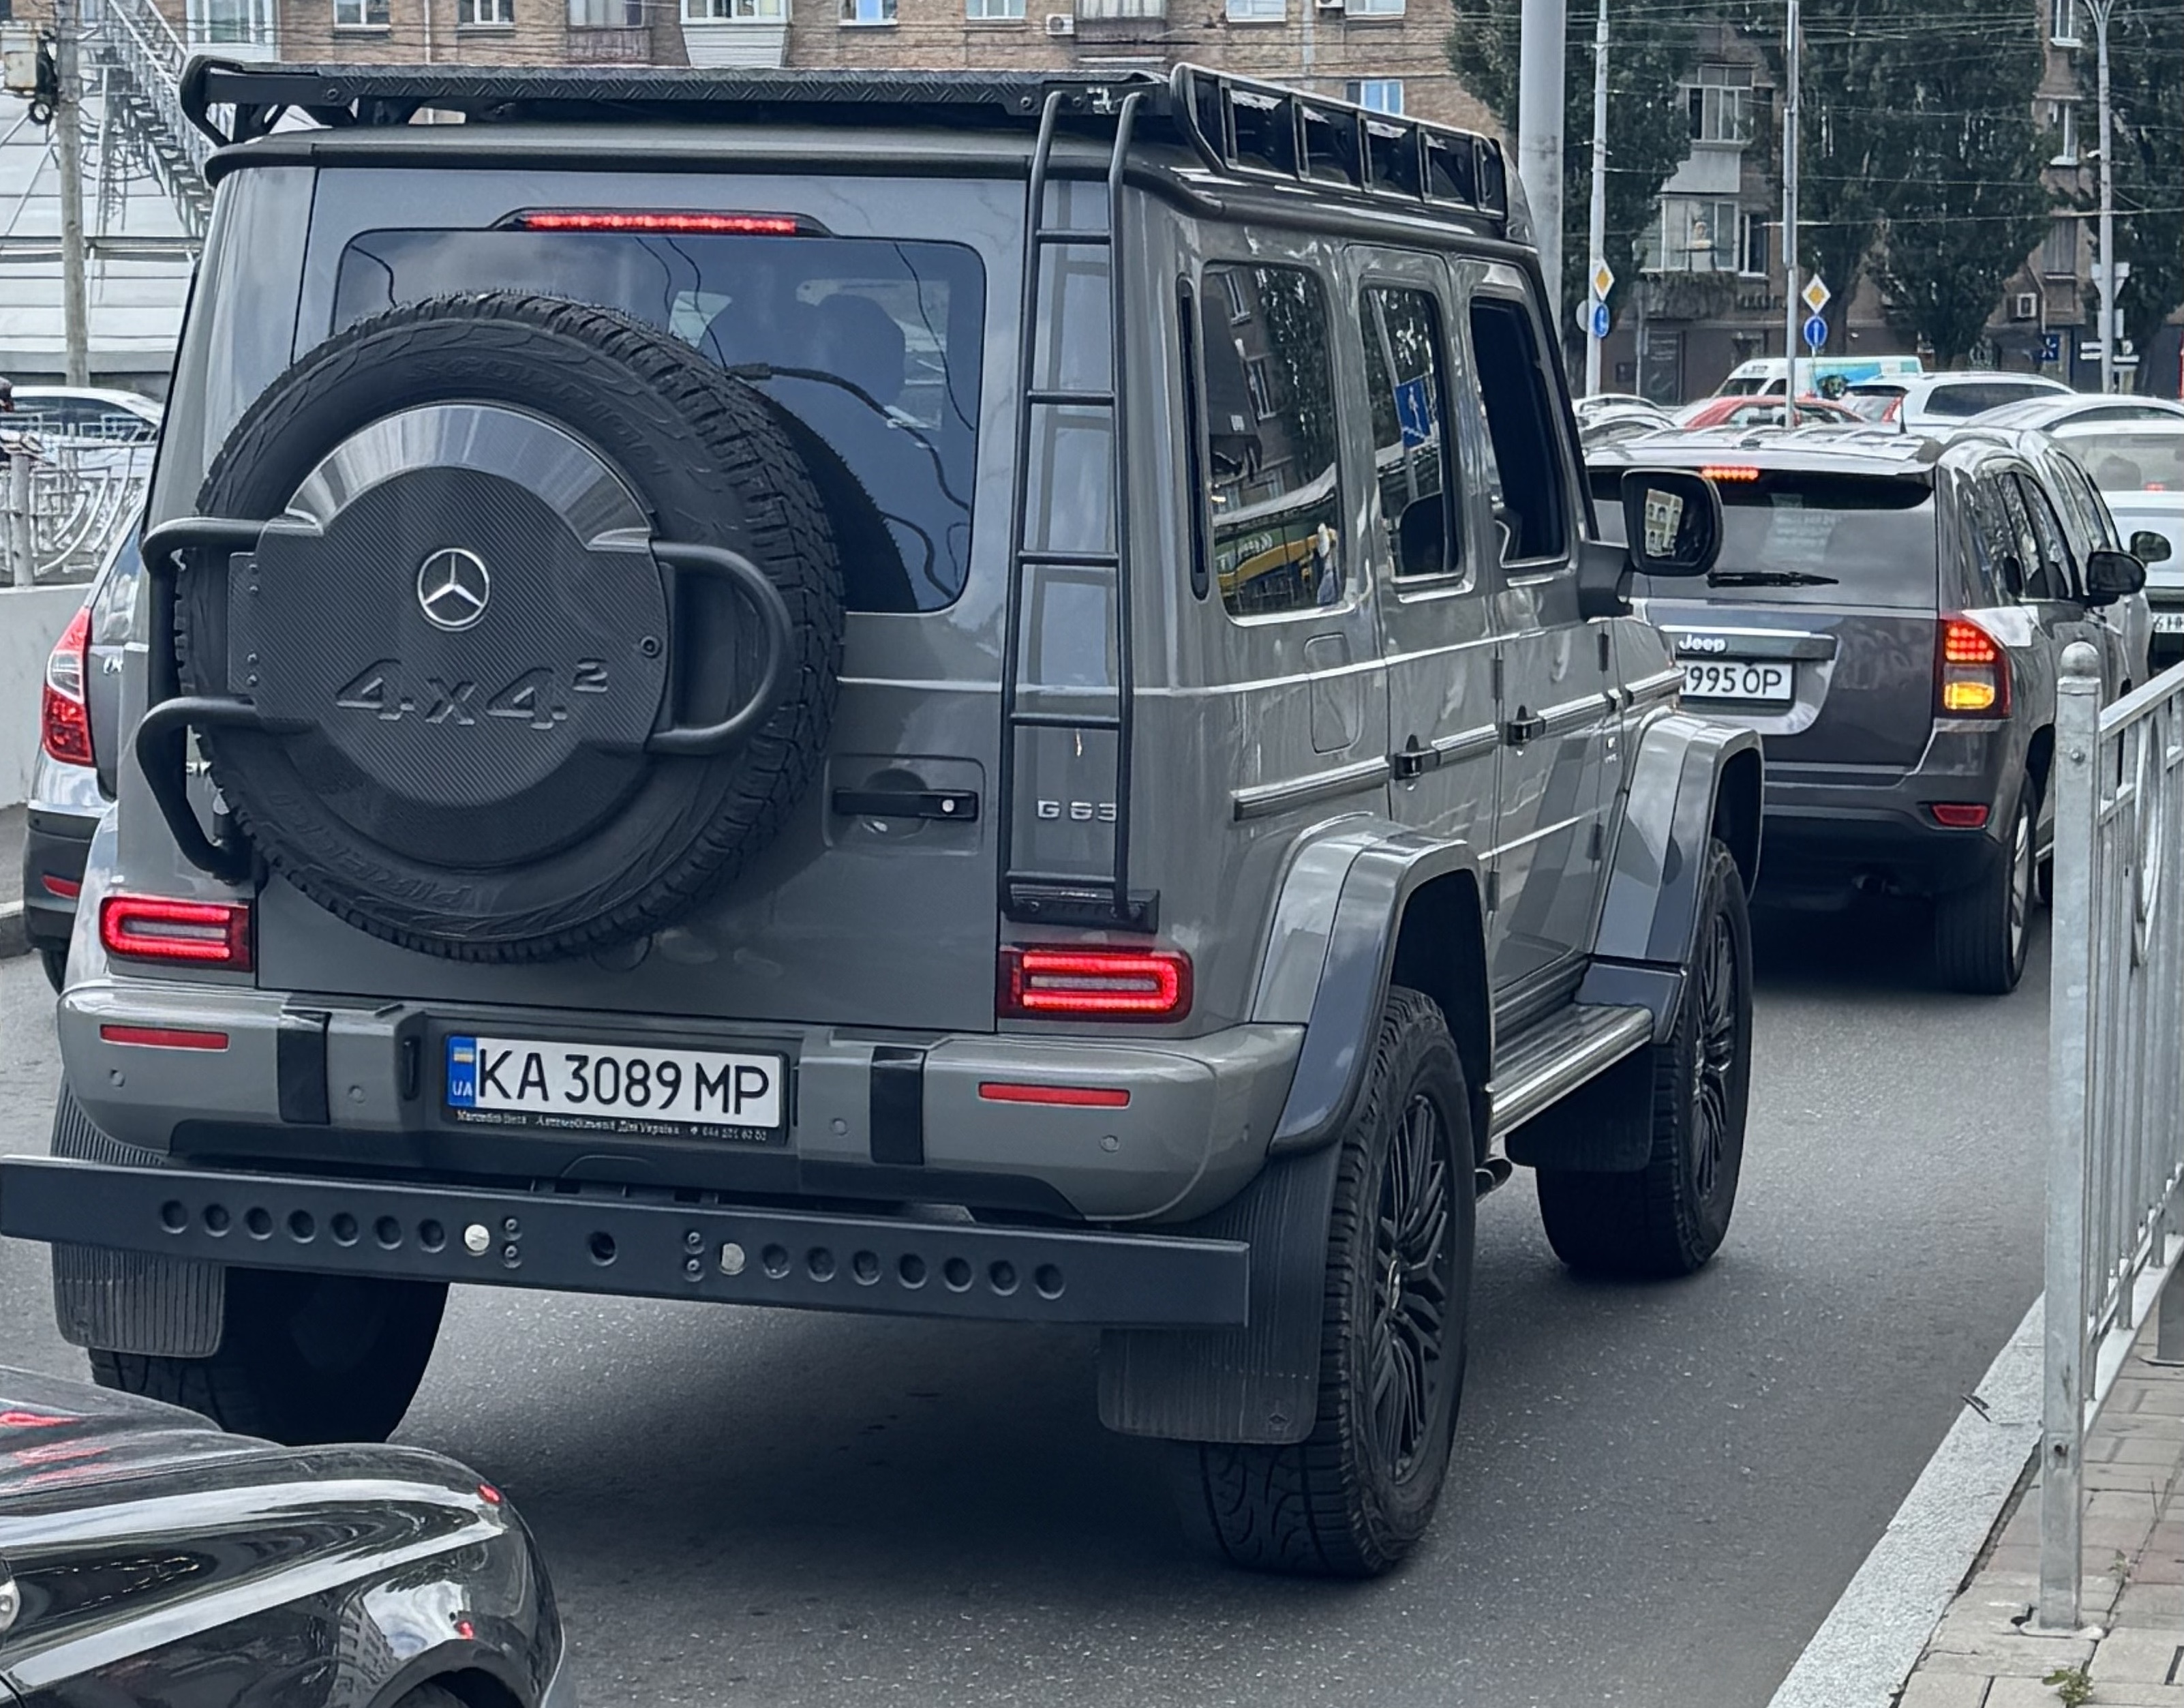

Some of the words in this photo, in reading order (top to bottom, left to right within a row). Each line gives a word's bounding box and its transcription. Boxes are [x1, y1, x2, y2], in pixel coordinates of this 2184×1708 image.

[1678, 634, 1726, 652] Jeep
[1742, 668, 1782, 695] OP
[452, 1079, 473, 1096] UA
[479, 1048, 549, 1101] KA
[564, 1053, 682, 1110] 3089
[694, 1062, 770, 1115] MP
